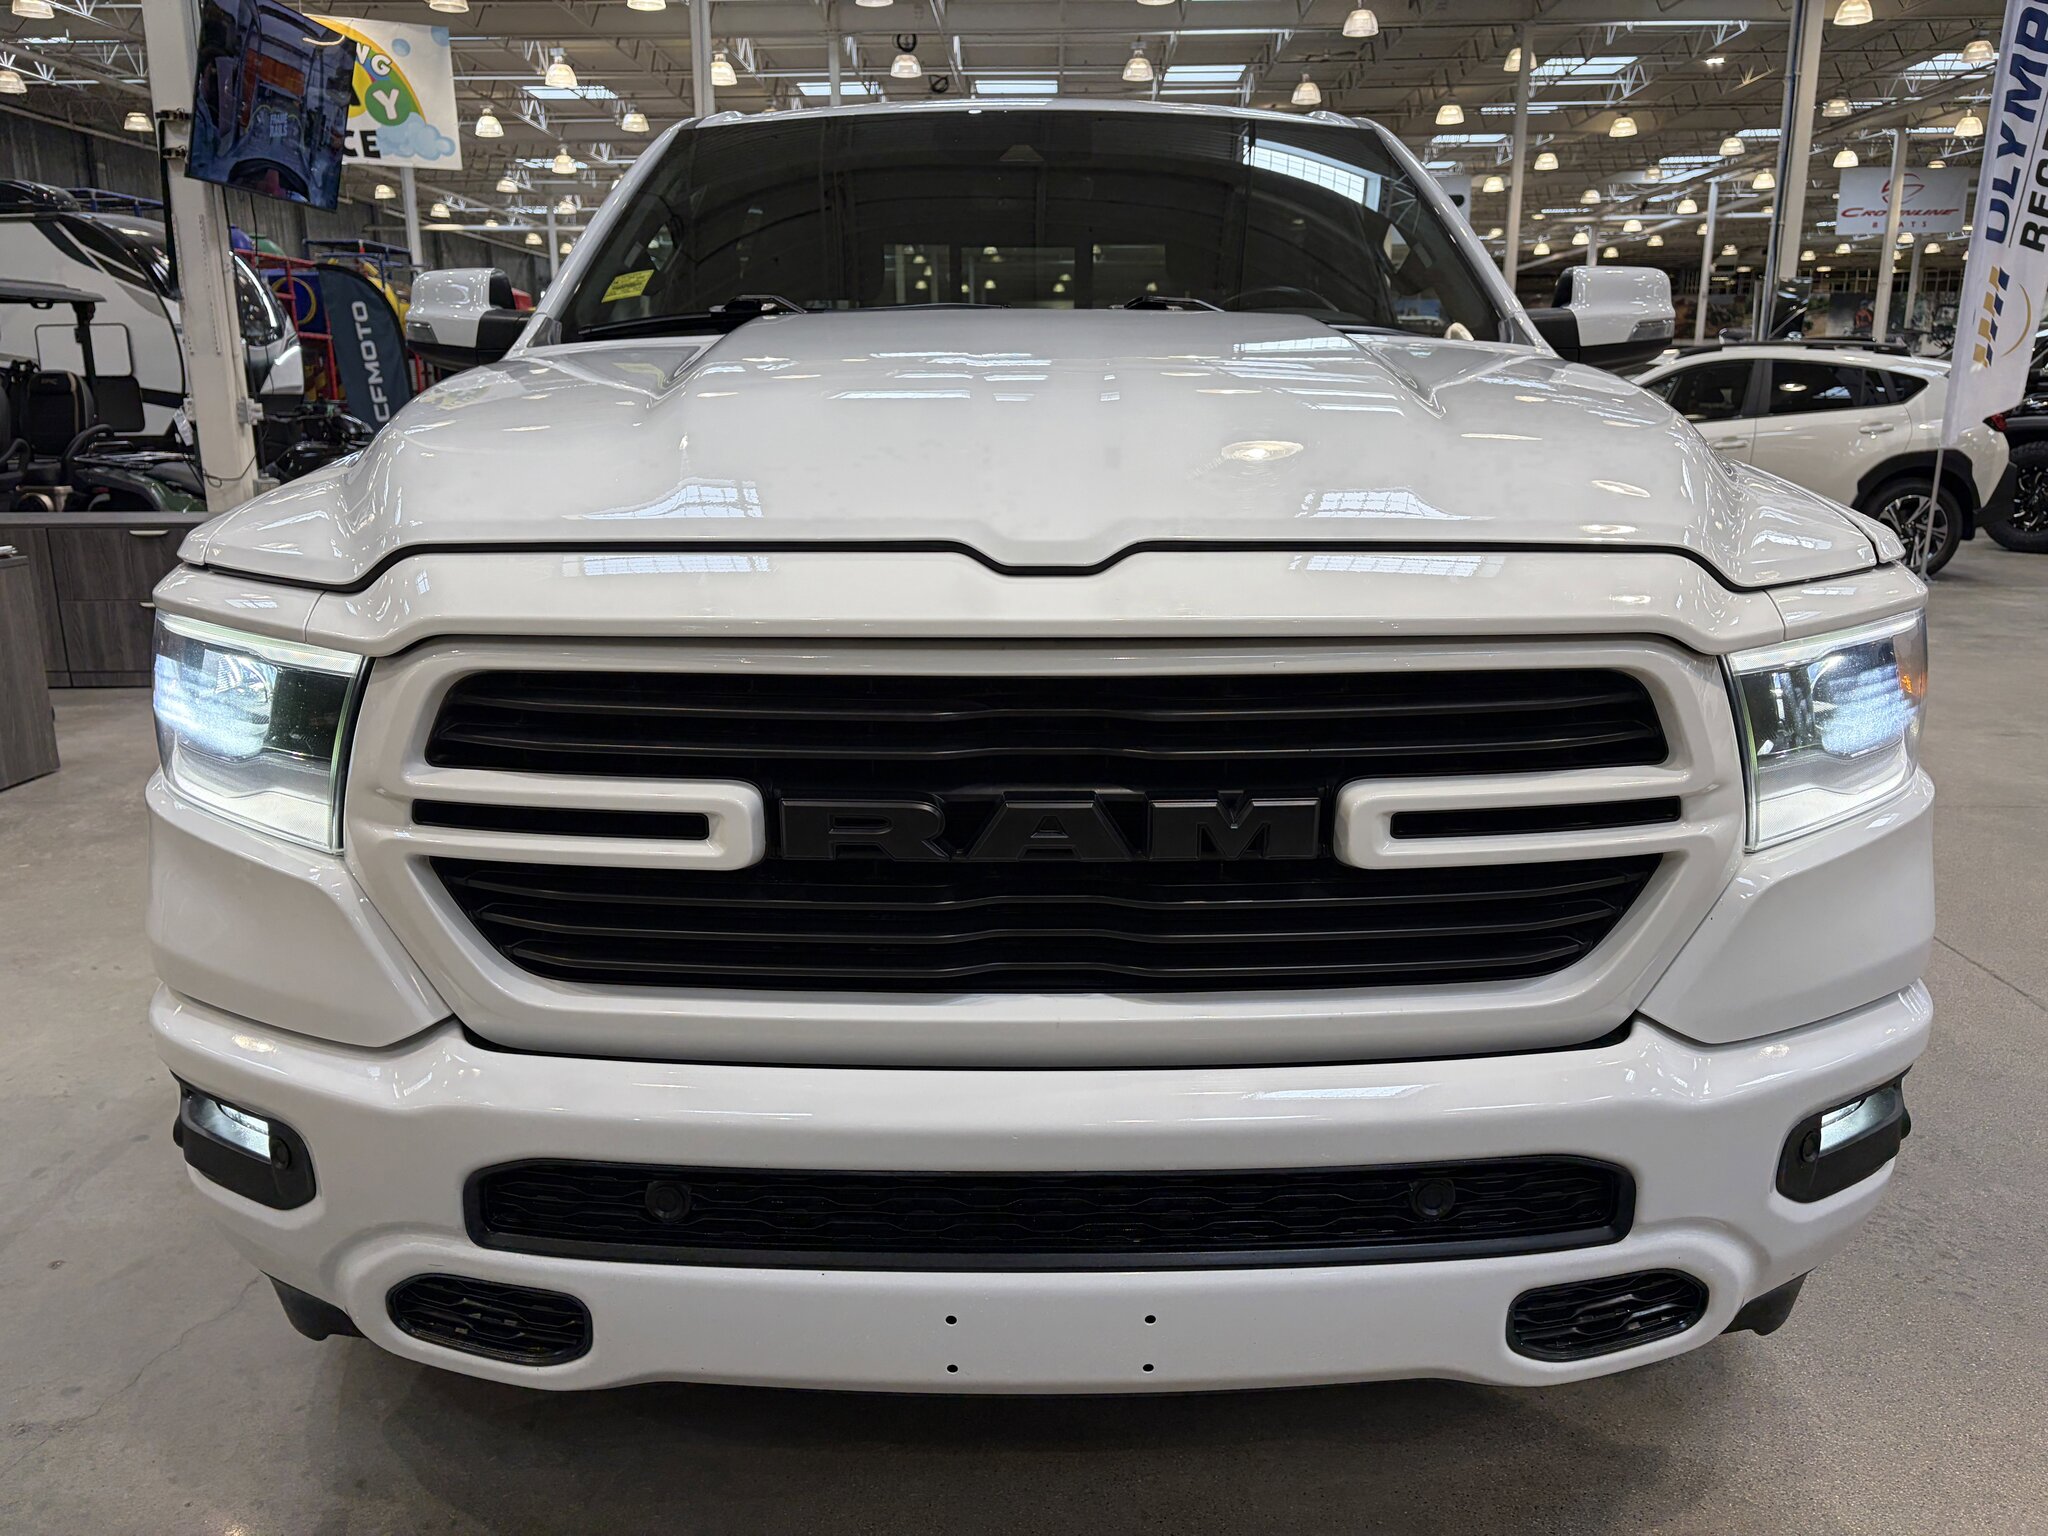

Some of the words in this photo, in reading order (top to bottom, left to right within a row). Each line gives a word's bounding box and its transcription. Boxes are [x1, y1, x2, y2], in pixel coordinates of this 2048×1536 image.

[1985, 0, 2048, 243] OLYMP
[1841, 207, 1960, 218] CRONLINE
[1872, 221, 1928, 229] BATS
[351, 301, 391, 422] CFMOTO
[781, 797, 1321, 860] RAM
